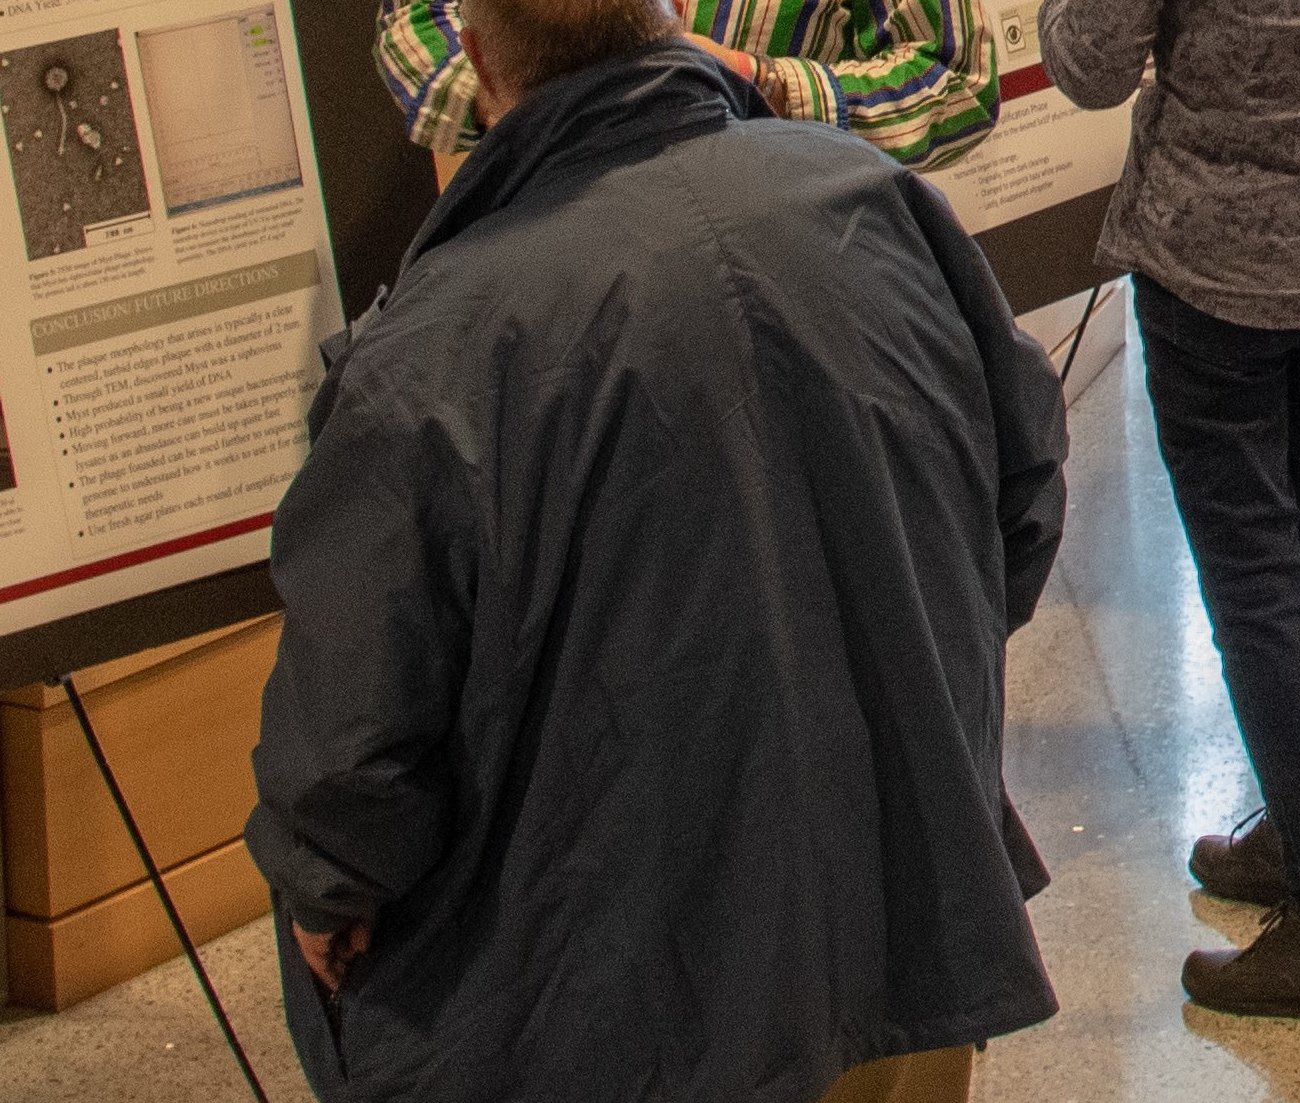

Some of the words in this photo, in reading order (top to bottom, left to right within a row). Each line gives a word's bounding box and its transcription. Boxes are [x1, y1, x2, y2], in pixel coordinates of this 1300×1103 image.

[7, 3, 30, 17] DNA
[134, 285, 192, 312] FUTURE
[194, 263, 278, 297] DIRECTIONS
[58, 360, 74, 373] The
[77, 353, 106, 370] plaque
[110, 339, 164, 359] morphology
[167, 332, 183, 344] that
[224, 312, 261, 331] typically
[272, 306, 292, 317] clear
[63, 386, 102, 405] Through
[133, 365, 182, 387] discovered
[184, 360, 207, 375] Myst
[210, 357, 227, 367] was
[66, 407, 89, 422] Myst
[92, 394, 134, 417] produced
[136, 395, 142, 403] a
[144, 385, 168, 401] small
[171, 379, 193, 397] yield
[195, 376, 205, 388] of
[207, 369, 232, 384] DNA
[68, 423, 92, 438] High
[94, 412, 143, 434] probability
[145, 406, 155, 418] of
[159, 402, 183, 414] being
[193, 395, 211, 406] new
[245, 370, 306, 392] bacteriophage
[78, 474, 96, 486] The
[98, 468, 126, 483] phage
[167, 453, 183, 463] can
[184, 448, 196, 458] be
[252, 432, 262, 440] to
[82, 487, 117, 505] genome
[119, 483, 130, 492] to
[131, 467, 180, 489] understand
[182, 465, 203, 475] how
[205, 460, 211, 470] it
[213, 454, 239, 467] works
[241, 451, 250, 460] to
[252, 448, 267, 457] use
[277, 441, 290, 450] for
[84, 500, 134, 519] therapeutic
[137, 491, 163, 506] needs
[88, 525, 106, 535] Use
[108, 515, 131, 530] fresh
[133, 512, 152, 525] agar
[155, 504, 180, 520] plates
[183, 495, 204, 510] each
[206, 488, 232, 504] round
[234, 484, 243, 496] of
